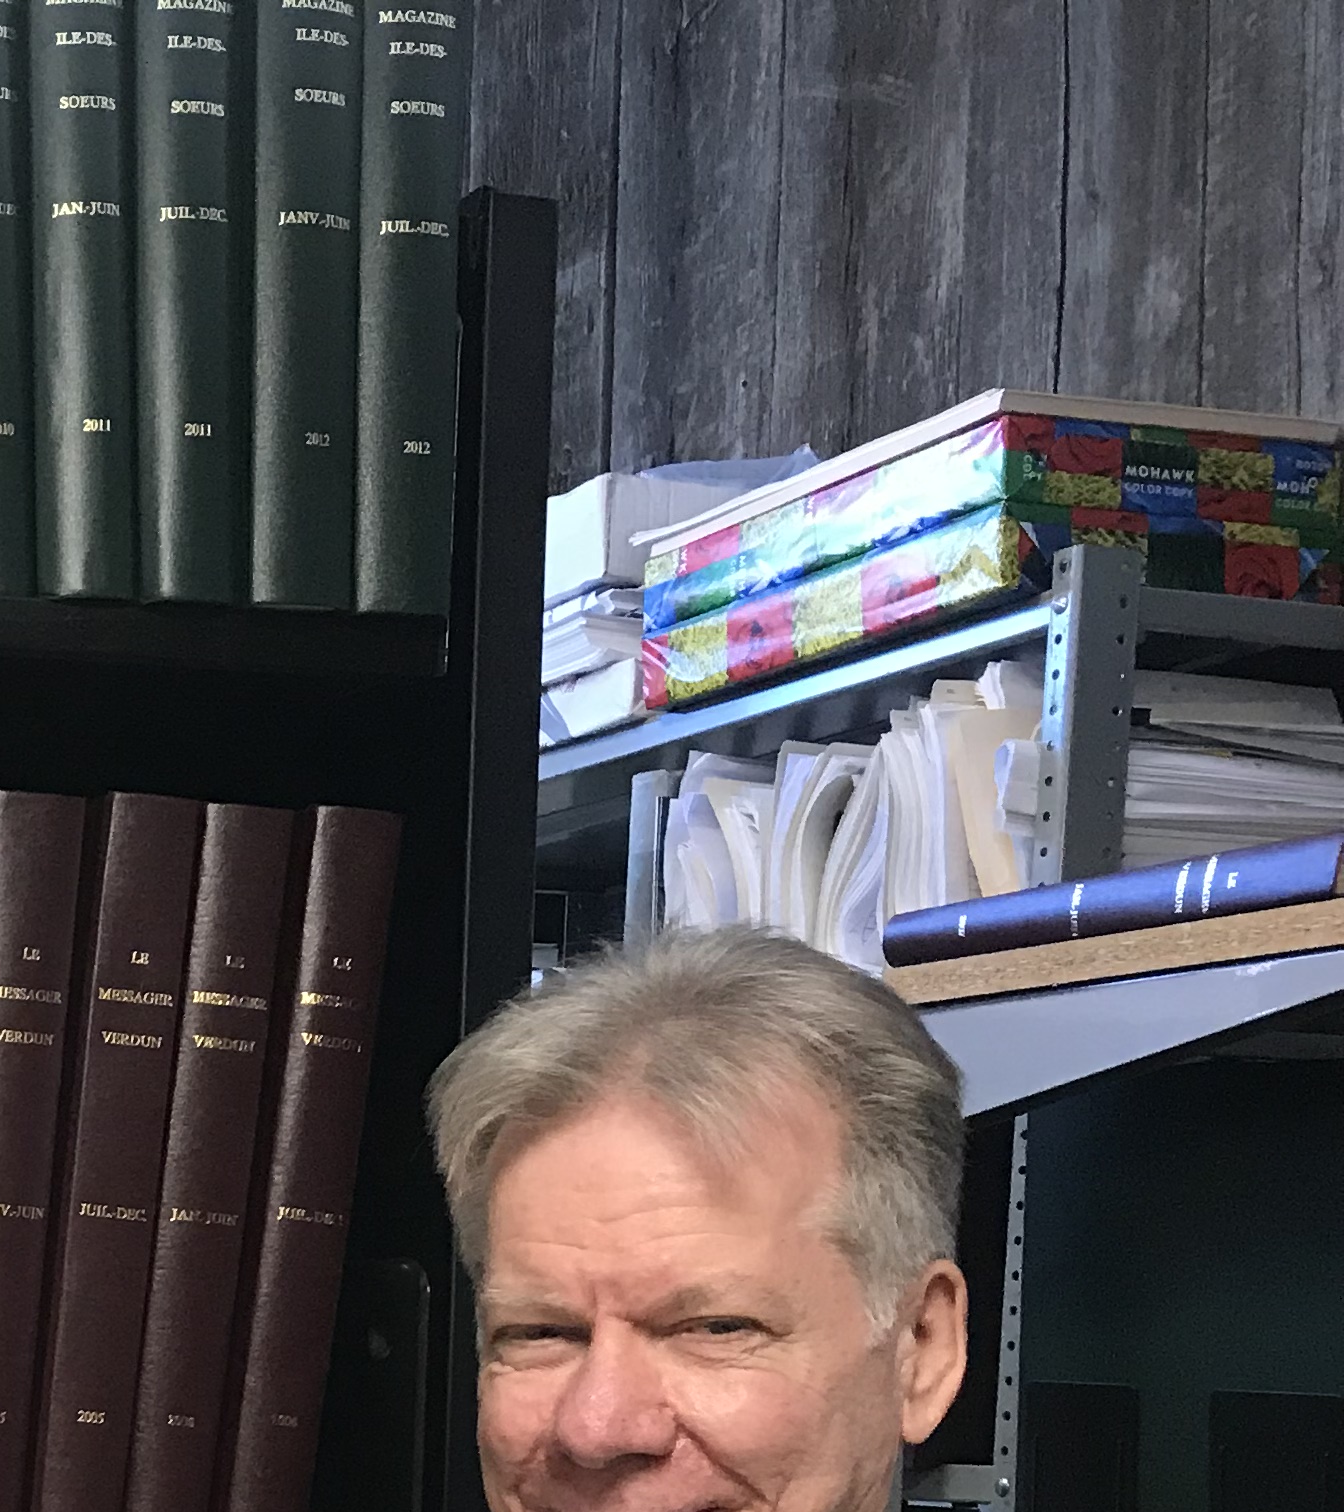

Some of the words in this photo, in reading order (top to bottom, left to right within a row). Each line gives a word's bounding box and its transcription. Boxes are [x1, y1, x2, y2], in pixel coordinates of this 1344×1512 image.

[378, 11, 457, 29] MAGAZINE
[59, 95, 116, 111] SOEURS
[294, 87, 347, 107] SOEURS
[170, 100, 225, 117] SOEURS
[390, 100, 445, 118] SOEURS
[82, 418, 112, 432] 2011
[184, 422, 212, 437] 2011
[304, 431, 331, 447] 2012
[403, 440, 431, 455] 2012
[1124, 464, 1196, 484] MOHAWK
[1124, 482, 1161, 496] COLOR
[1164, 485, 1196, 498] COPY
[22, 946, 41, 961] LE
[130, 950, 150, 965] LE
[98, 987, 174, 1007] MESSAGER
[101, 1030, 163, 1049] VERDUN
